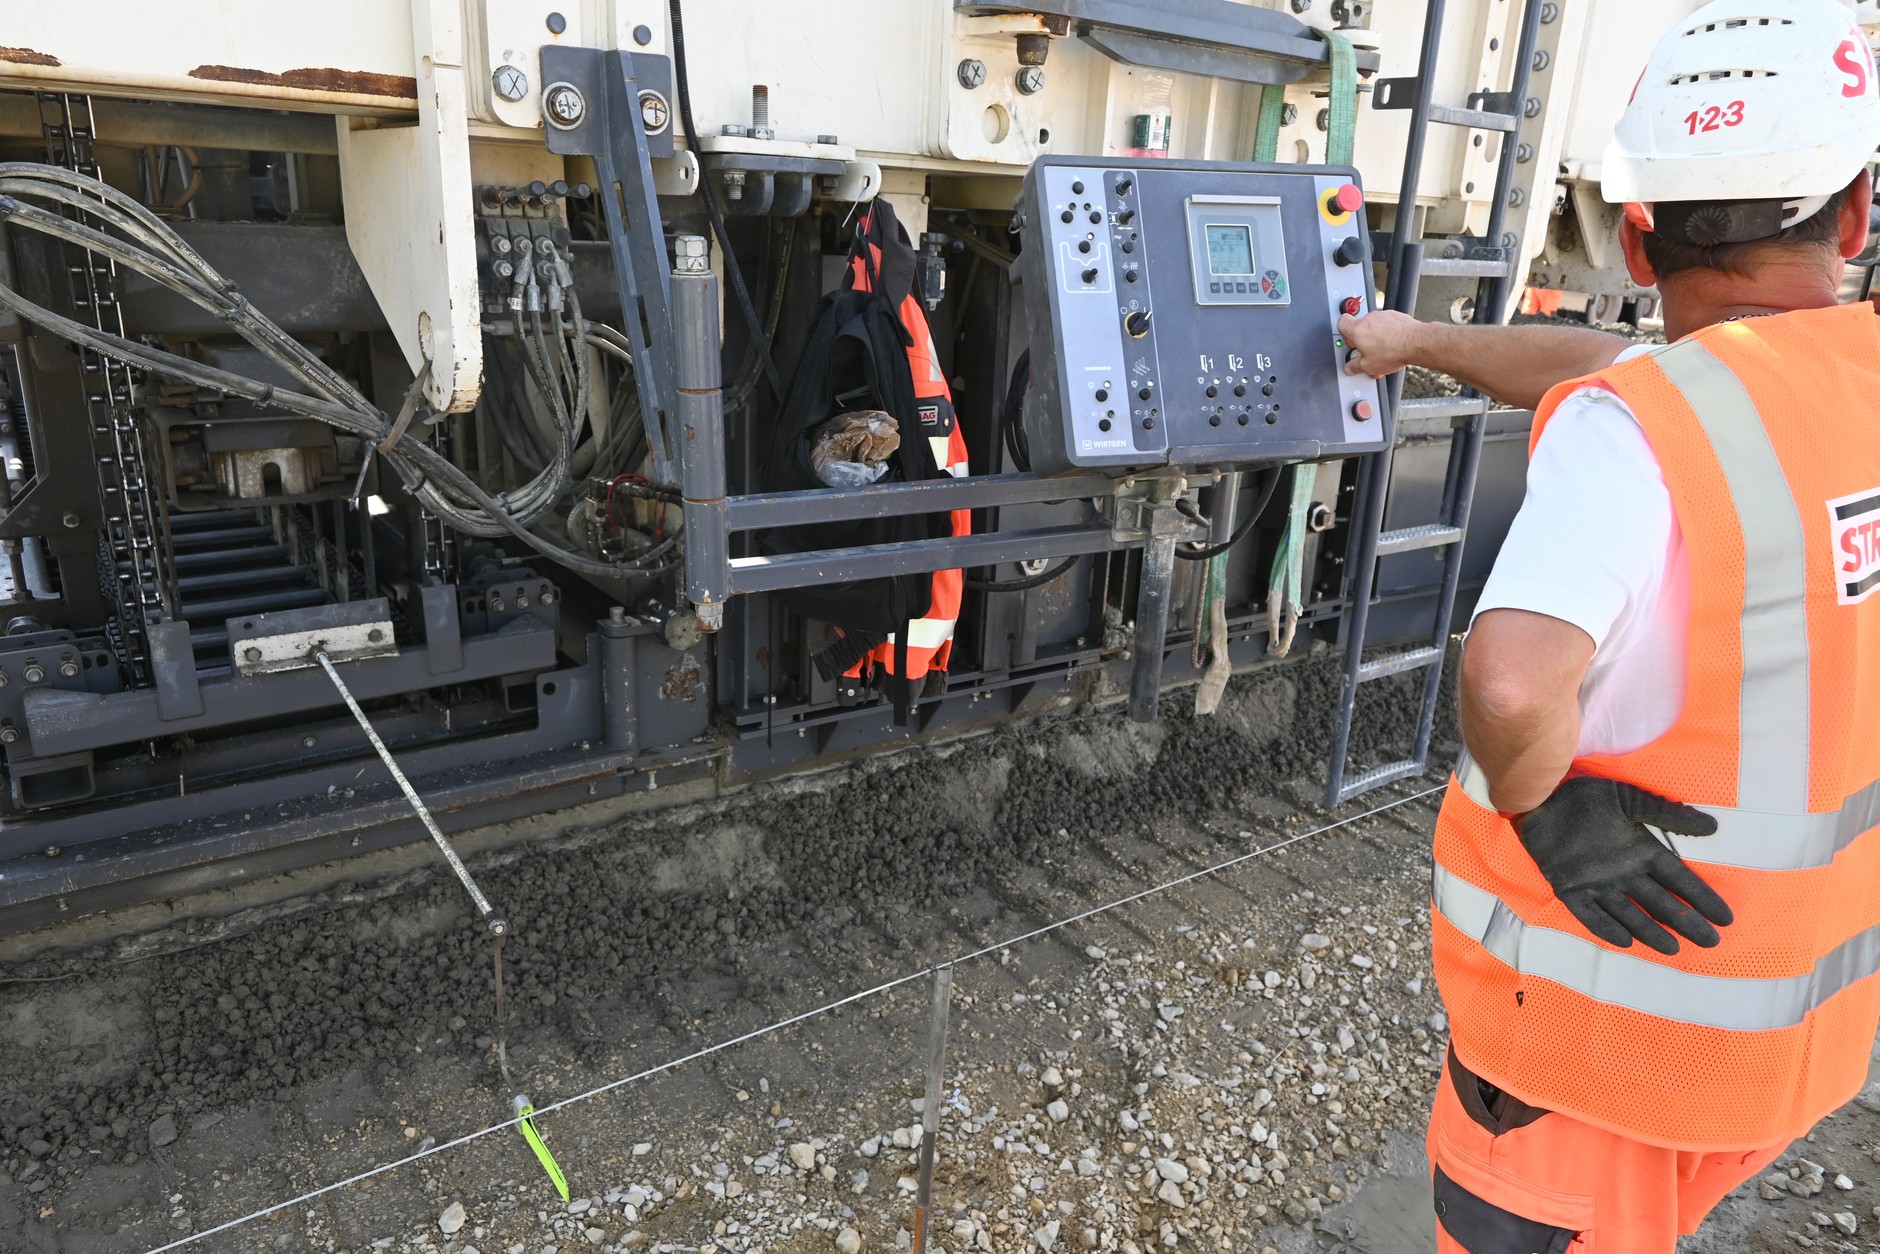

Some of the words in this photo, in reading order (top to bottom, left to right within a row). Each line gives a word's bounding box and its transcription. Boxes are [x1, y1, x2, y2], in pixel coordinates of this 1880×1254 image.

[1208, 358, 1214, 369] 1
[1236, 357, 1243, 369] 2
[1263, 356, 1272, 368] 3
[1093, 440, 1127, 448] WIRTGEN
